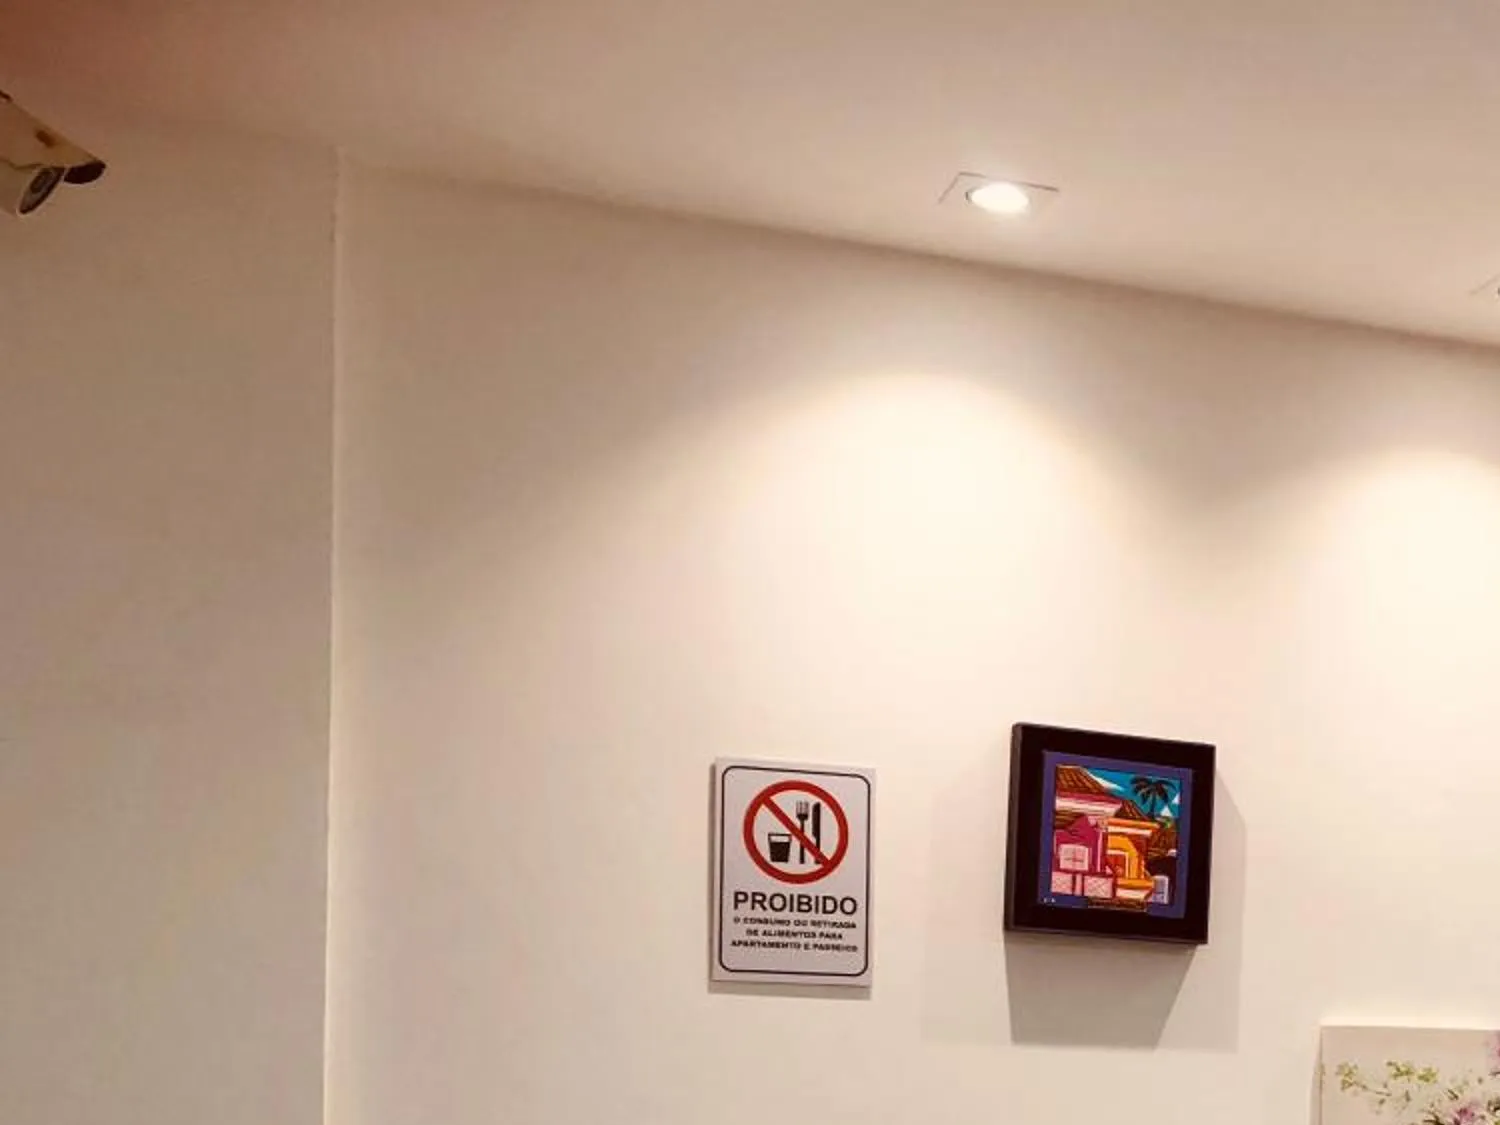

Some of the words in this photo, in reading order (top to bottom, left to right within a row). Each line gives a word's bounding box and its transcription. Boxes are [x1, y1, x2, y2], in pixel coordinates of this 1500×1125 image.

[733, 891, 858, 915] PROIBIDO
[733, 916, 741, 925] O
[743, 916, 791, 927] CONSUMO
[793, 918, 808, 927] OU
[810, 919, 857, 929] RETIRADA
[745, 928, 759, 937] DE
[761, 929, 817, 939] ALIMENTOS
[818, 931, 843, 940] PARA
[730, 939, 801, 950] APARTAMENTO
